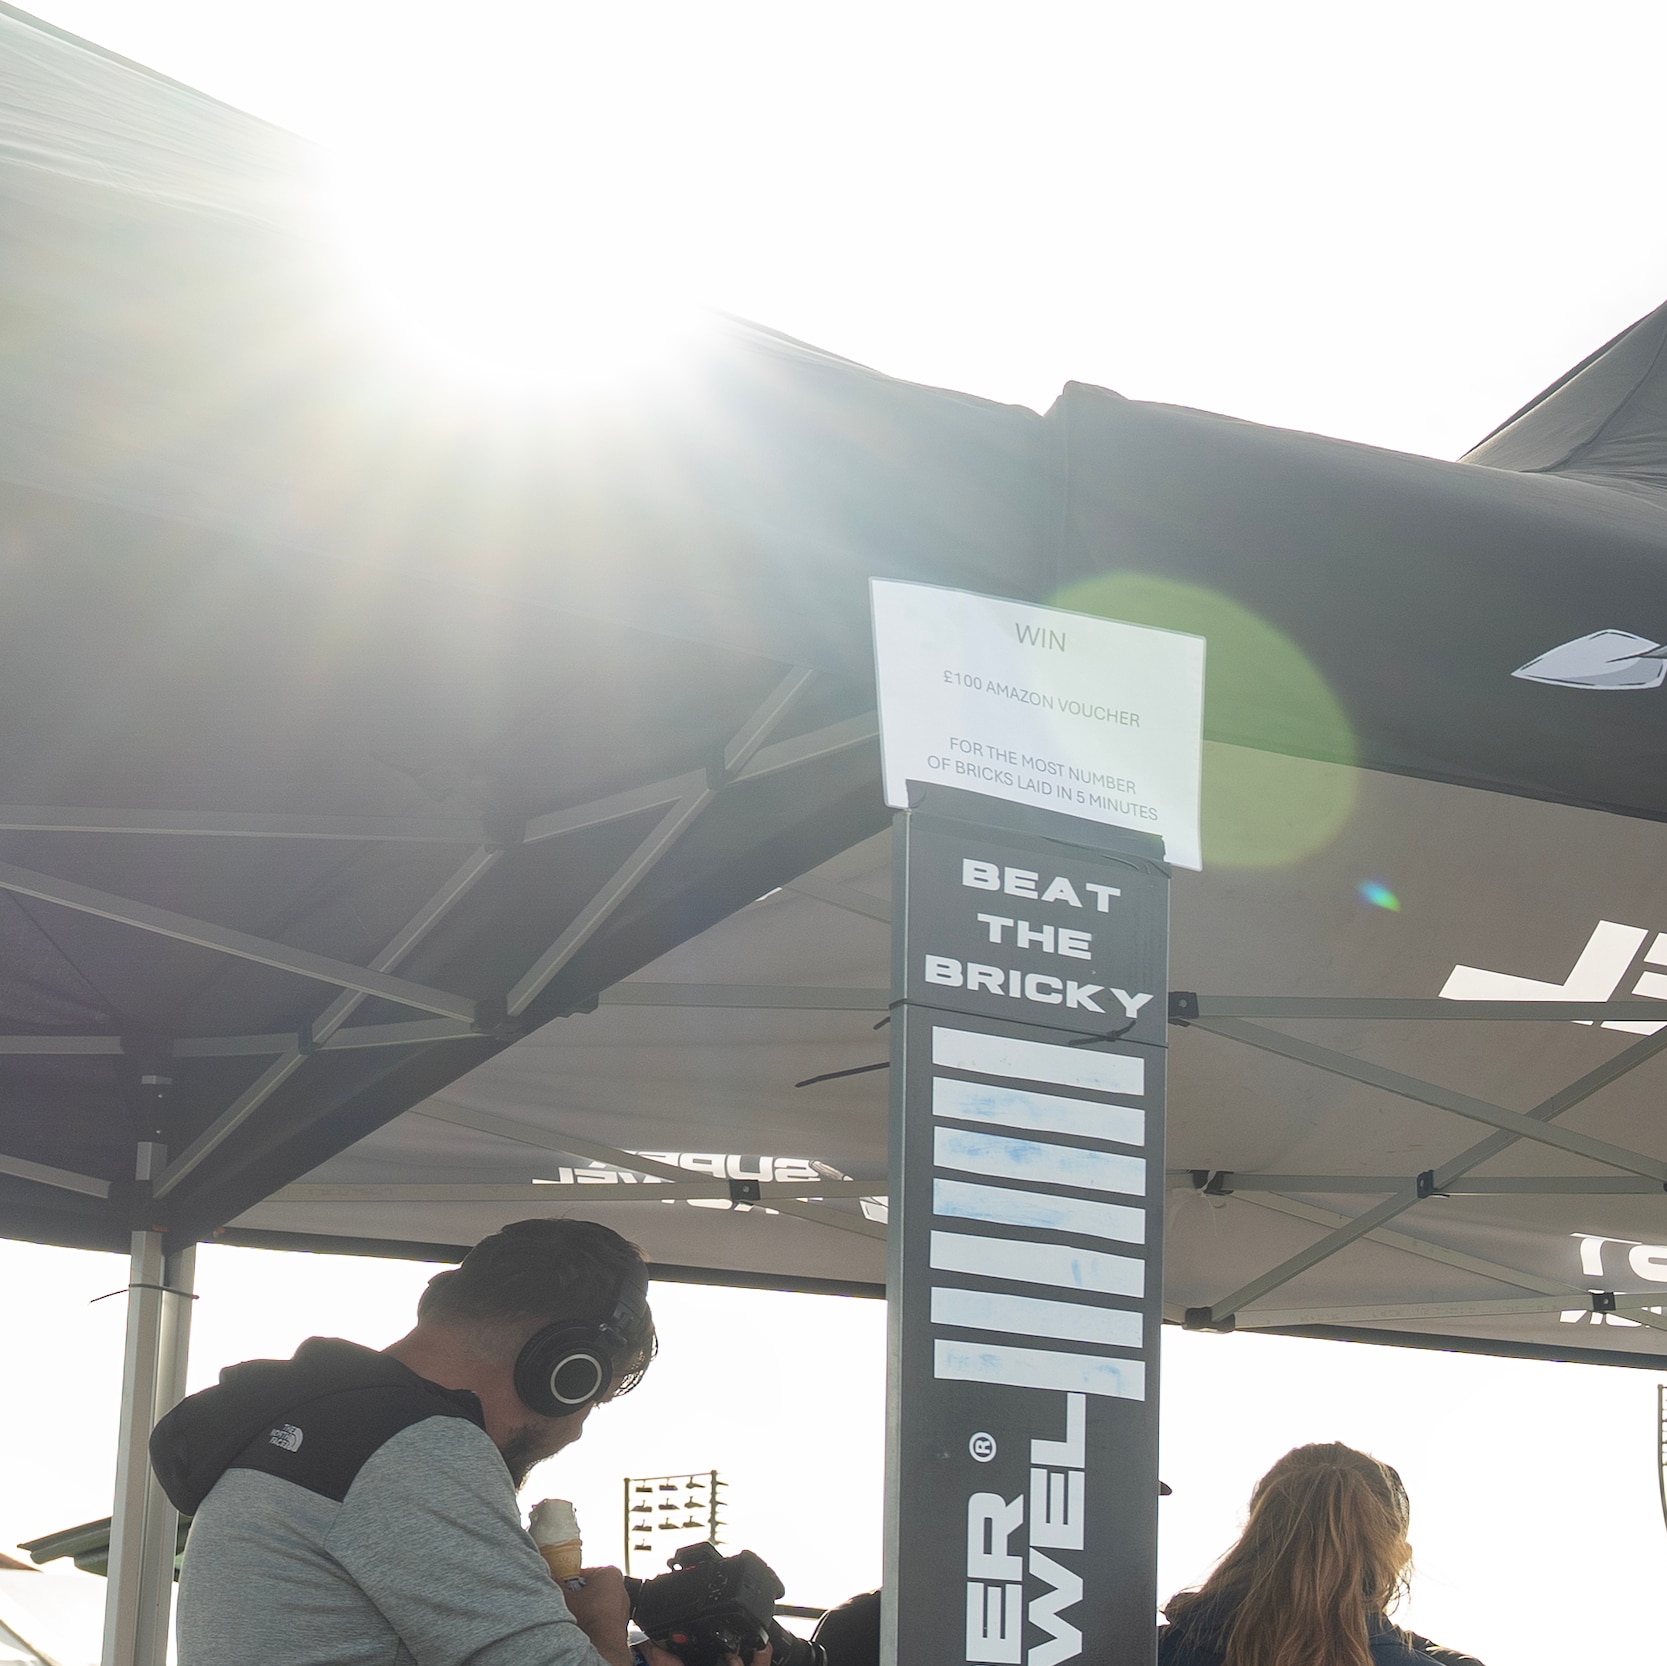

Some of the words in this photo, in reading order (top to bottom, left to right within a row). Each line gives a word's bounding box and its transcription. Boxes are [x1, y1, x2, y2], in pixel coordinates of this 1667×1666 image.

[1015, 622, 1067, 652] WIN
[943, 669, 983, 690] £100
[985, 680, 1054, 709] AMAZON
[1057, 697, 1141, 728] VOUCHER
[927, 755, 951, 771] OF
[955, 760, 1014, 786] BRICKS
[1017, 775, 1053, 796] LAID
[1056, 784, 1073, 801] IN
[1076, 790, 1086, 804] 5
[1089, 793, 1159, 821] MINUTES
[949, 737, 983, 757] FOR
[986, 745, 1018, 765] THE
[1021, 754, 1065, 777] MOST
[1068, 766, 1137, 795] NUMBER
[961, 858, 1122, 914] BEAT
[977, 912, 1093, 960] THE
[924, 954, 1155, 1020] BRICKY
